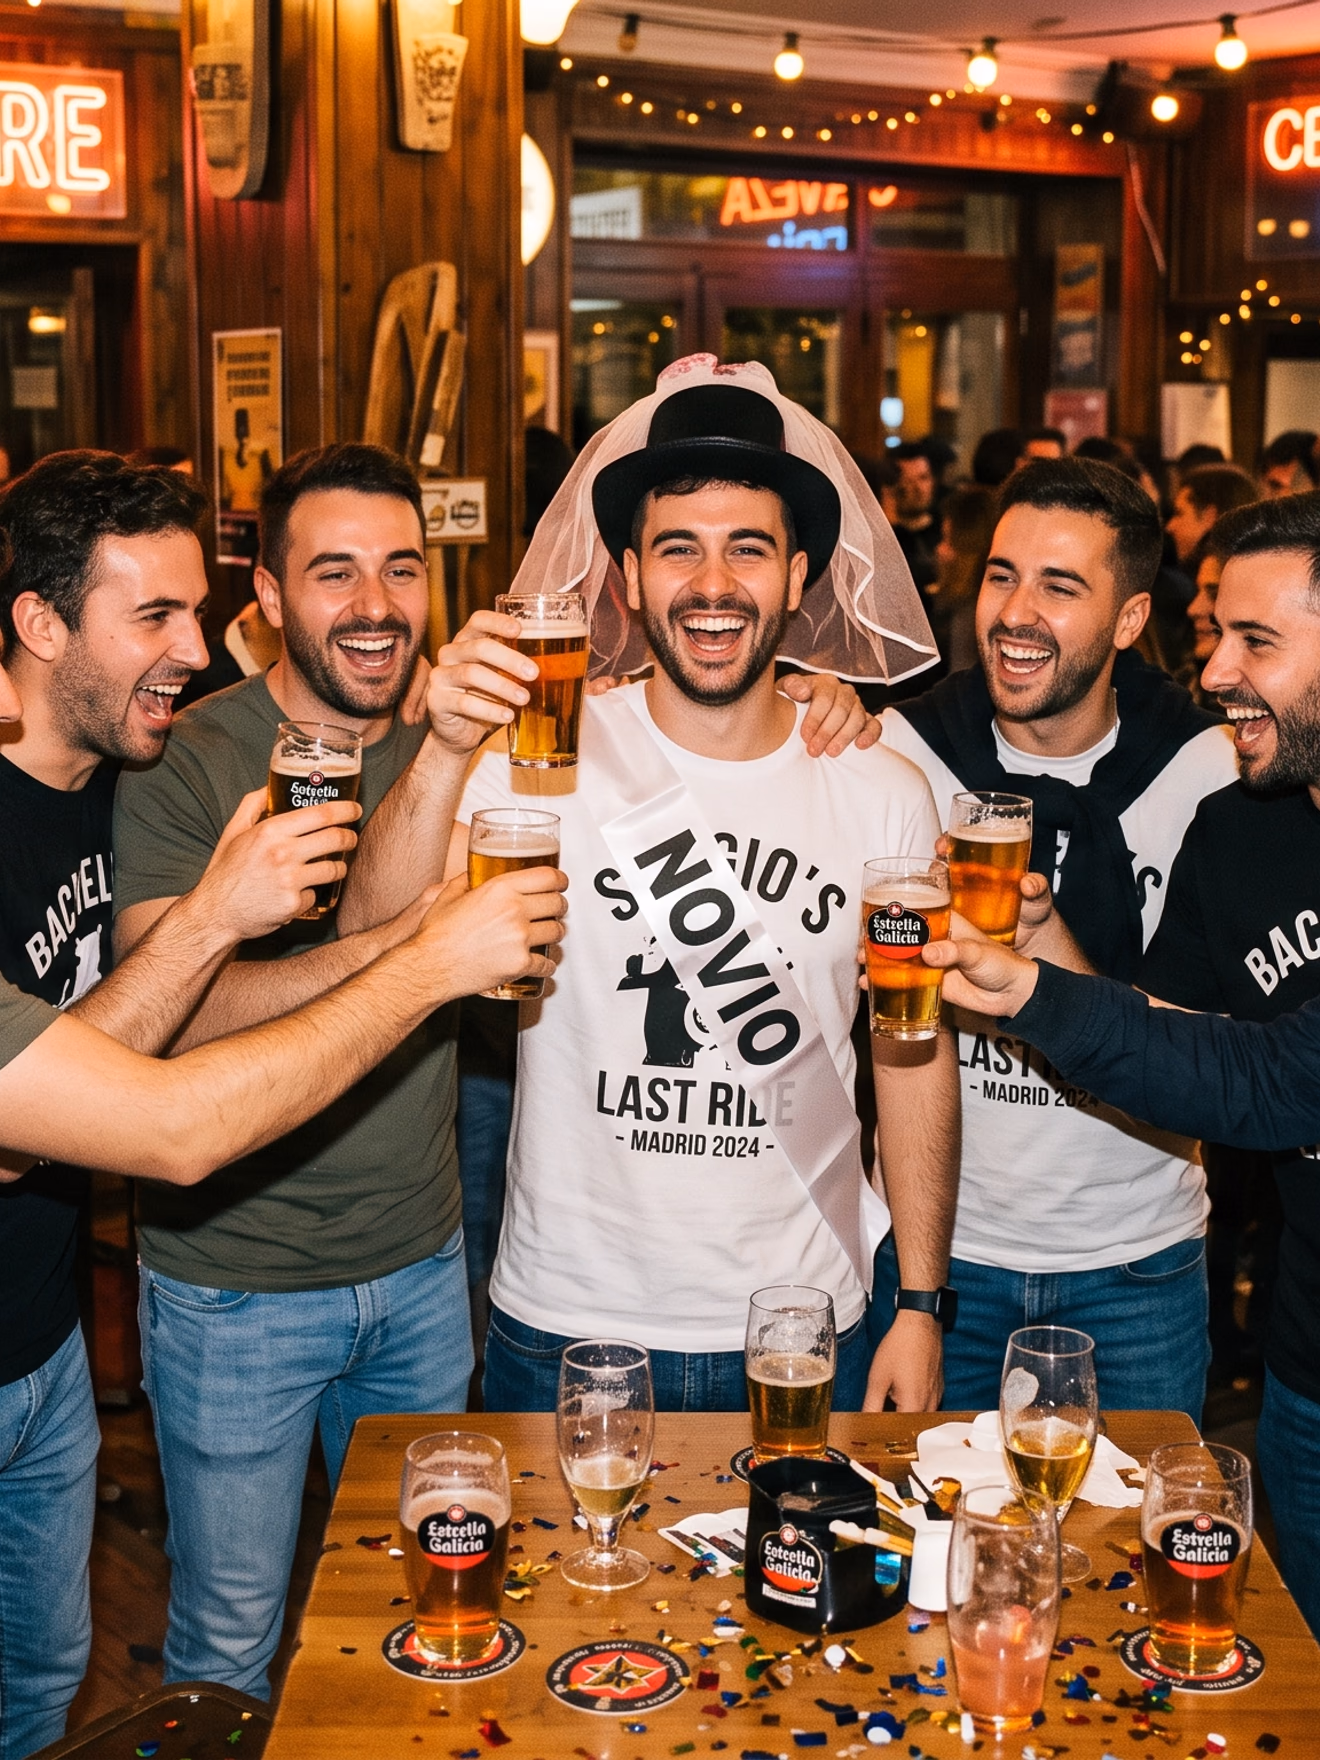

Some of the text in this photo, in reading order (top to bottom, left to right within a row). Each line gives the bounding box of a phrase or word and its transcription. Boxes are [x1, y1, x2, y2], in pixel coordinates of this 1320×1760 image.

[593, 832, 847, 934] SIO'S
[633, 828, 801, 1066] NOVIO
[875, 929, 920, 944] Galicia
[959, 1032, 1032, 1078] AST
[597, 1070, 697, 1124] LAST
[983, 1080, 1049, 1106] MADRID
[630, 1129, 707, 1156] MADRID
[712, 1135, 760, 1158] 2024
[429, 1536, 484, 1553] Galicia
[1172, 1528, 1232, 1547] Estrella
[1173, 1545, 1229, 1563] Galicia
